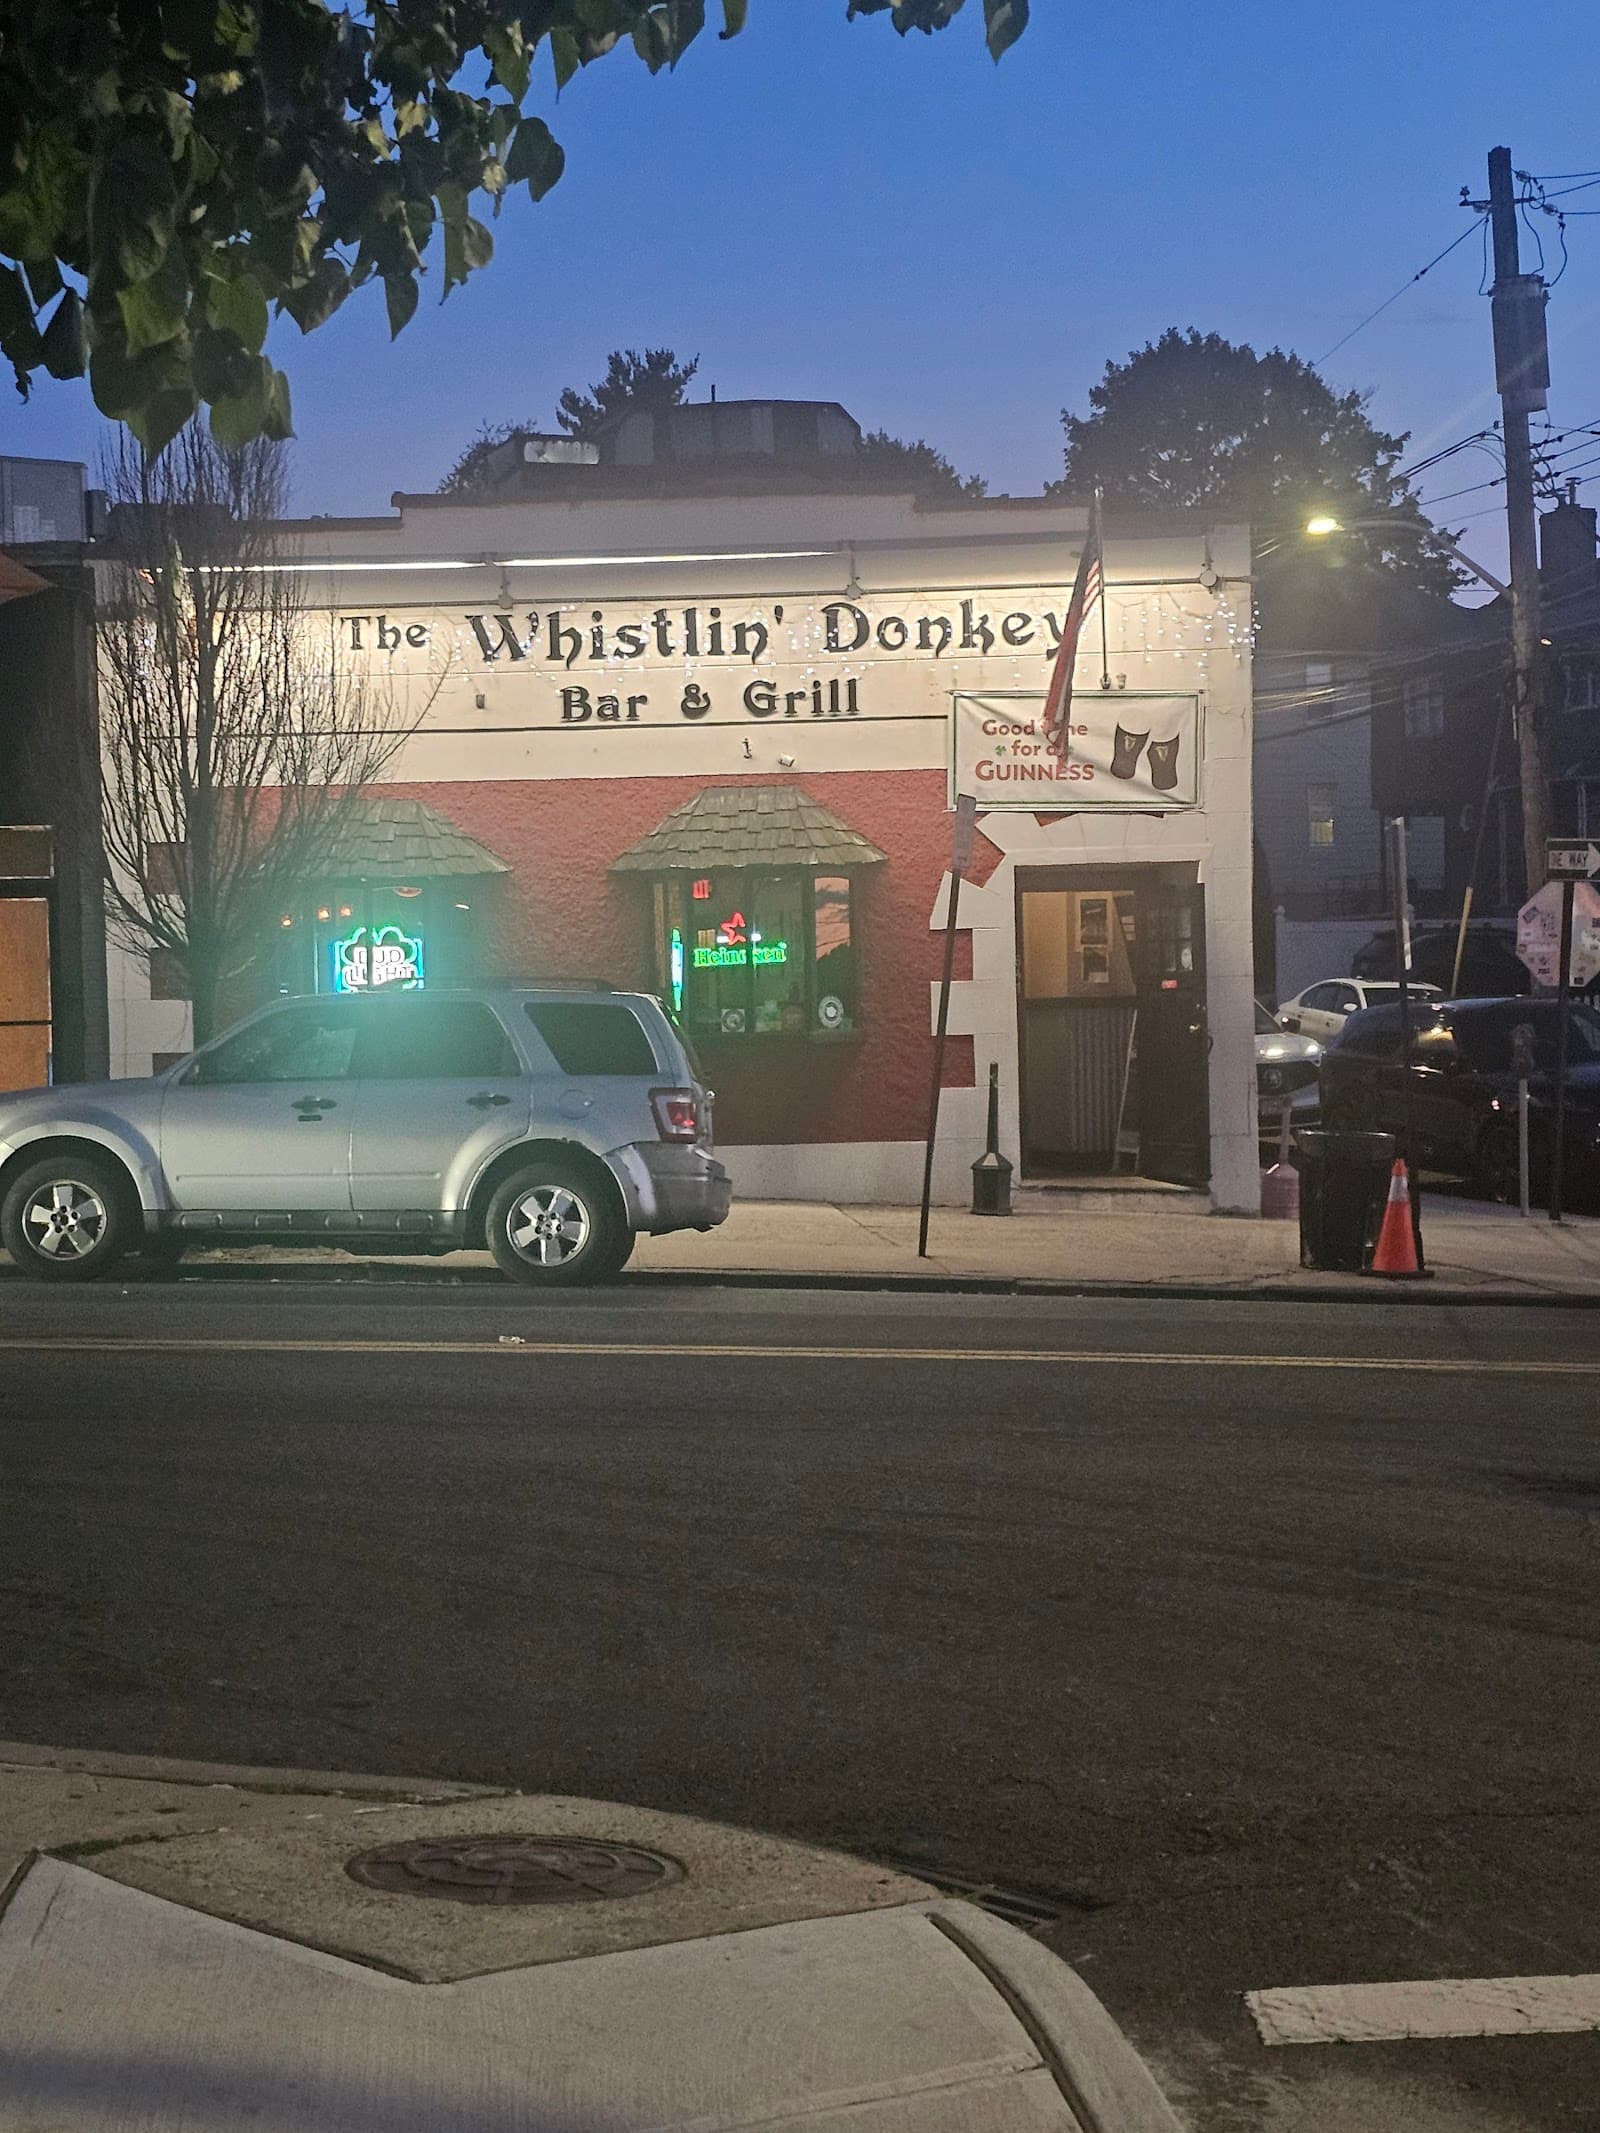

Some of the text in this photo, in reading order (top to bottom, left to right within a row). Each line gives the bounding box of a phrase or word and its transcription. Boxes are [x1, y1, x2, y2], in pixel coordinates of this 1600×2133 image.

[340, 615, 428, 654] The
[464, 605, 783, 669] Whistlin'
[560, 678, 862, 722] Bar & Grill
[982, 719, 1035, 736] Good
[1011, 739, 1041, 756] for
[975, 760, 1095, 781] GUINNESS
[1569, 853, 1589, 867] WAY
